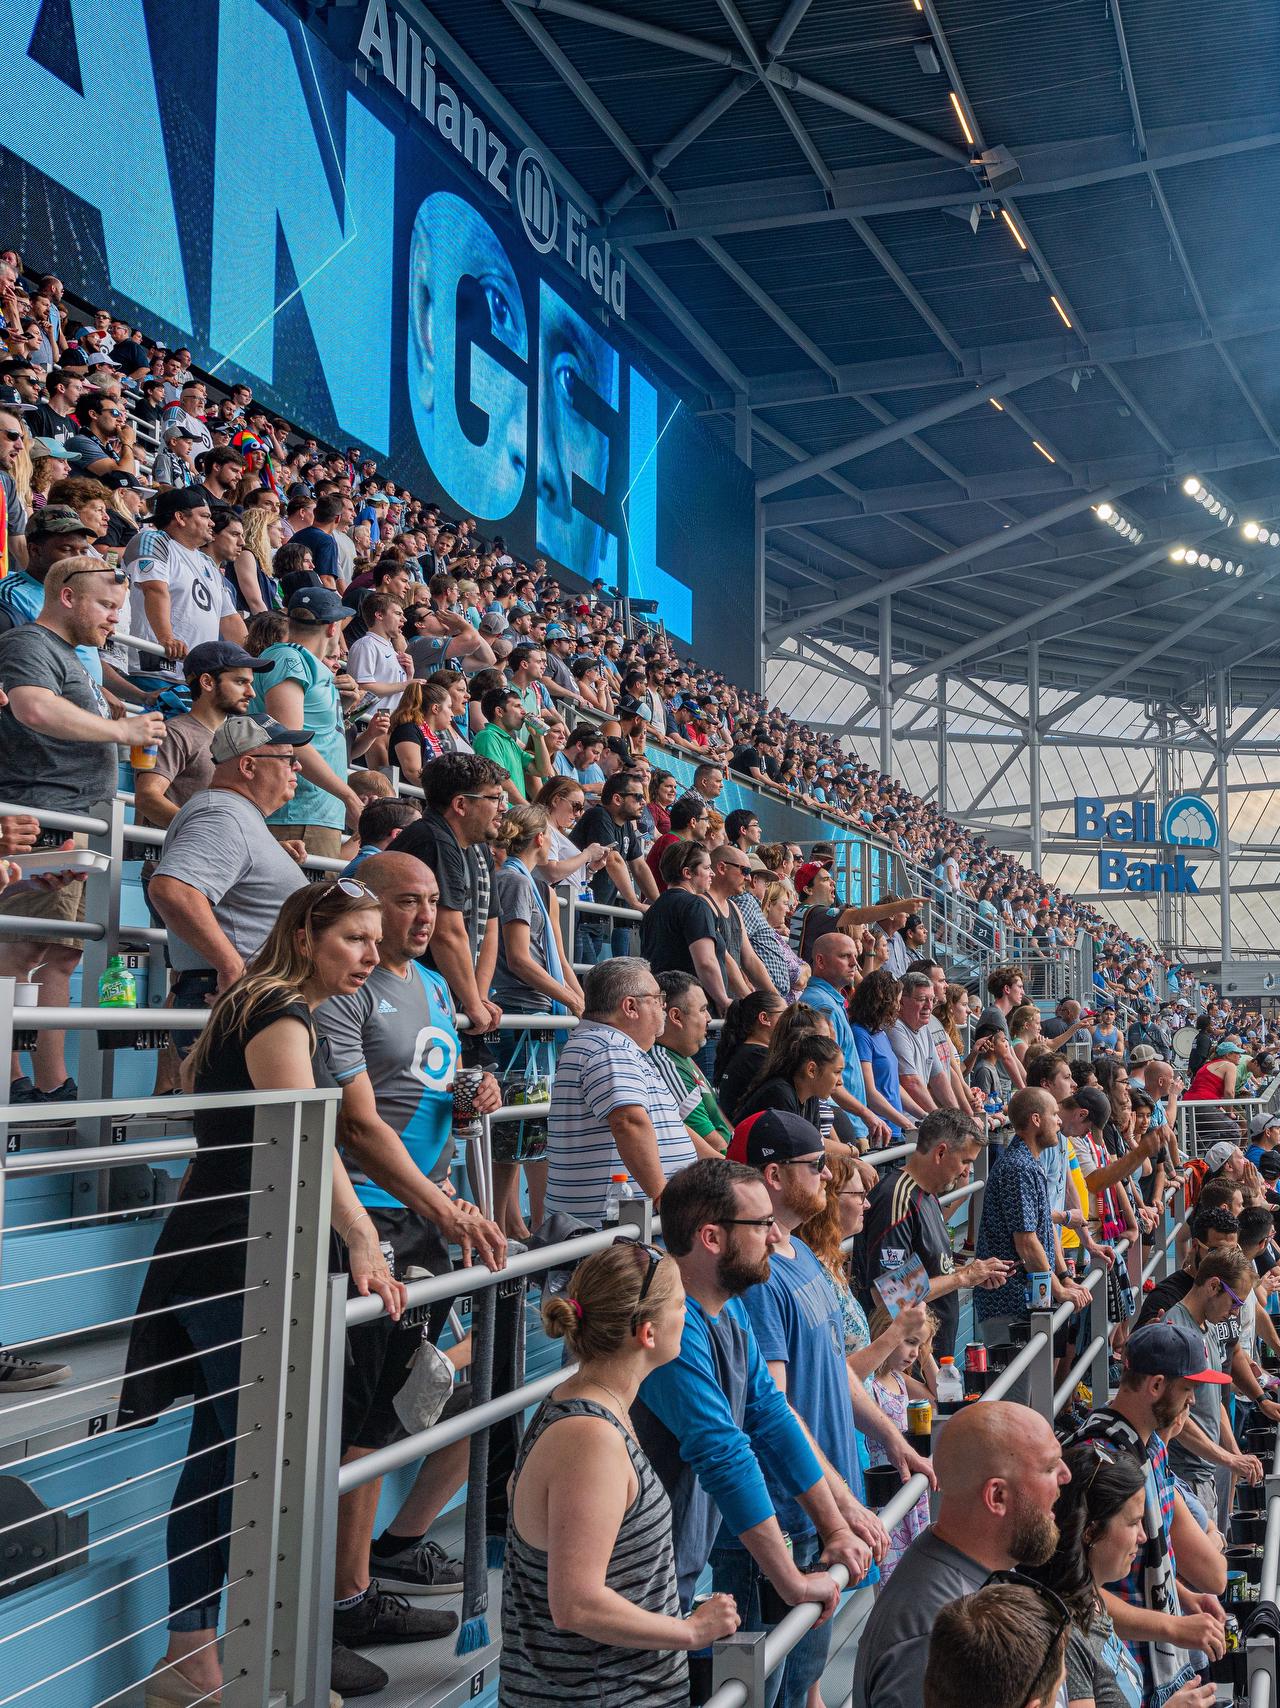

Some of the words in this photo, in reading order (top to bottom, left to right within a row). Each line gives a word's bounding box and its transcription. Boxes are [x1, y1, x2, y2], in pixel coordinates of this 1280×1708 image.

[358, 0, 508, 199] Allianz
[566, 201, 626, 320] Field
[0, 0, 692, 645] ANGEL
[1074, 797, 1155, 842] Bell
[1098, 850, 1200, 893] Bank
[130, 956, 136, 968] 6
[8, 1136, 16, 1151] 4
[116, 1128, 122, 1141] 5
[463, 1300, 468, 1312] 6
[94, 1418, 101, 1435] 2
[474, 1675, 482, 1695] 5
